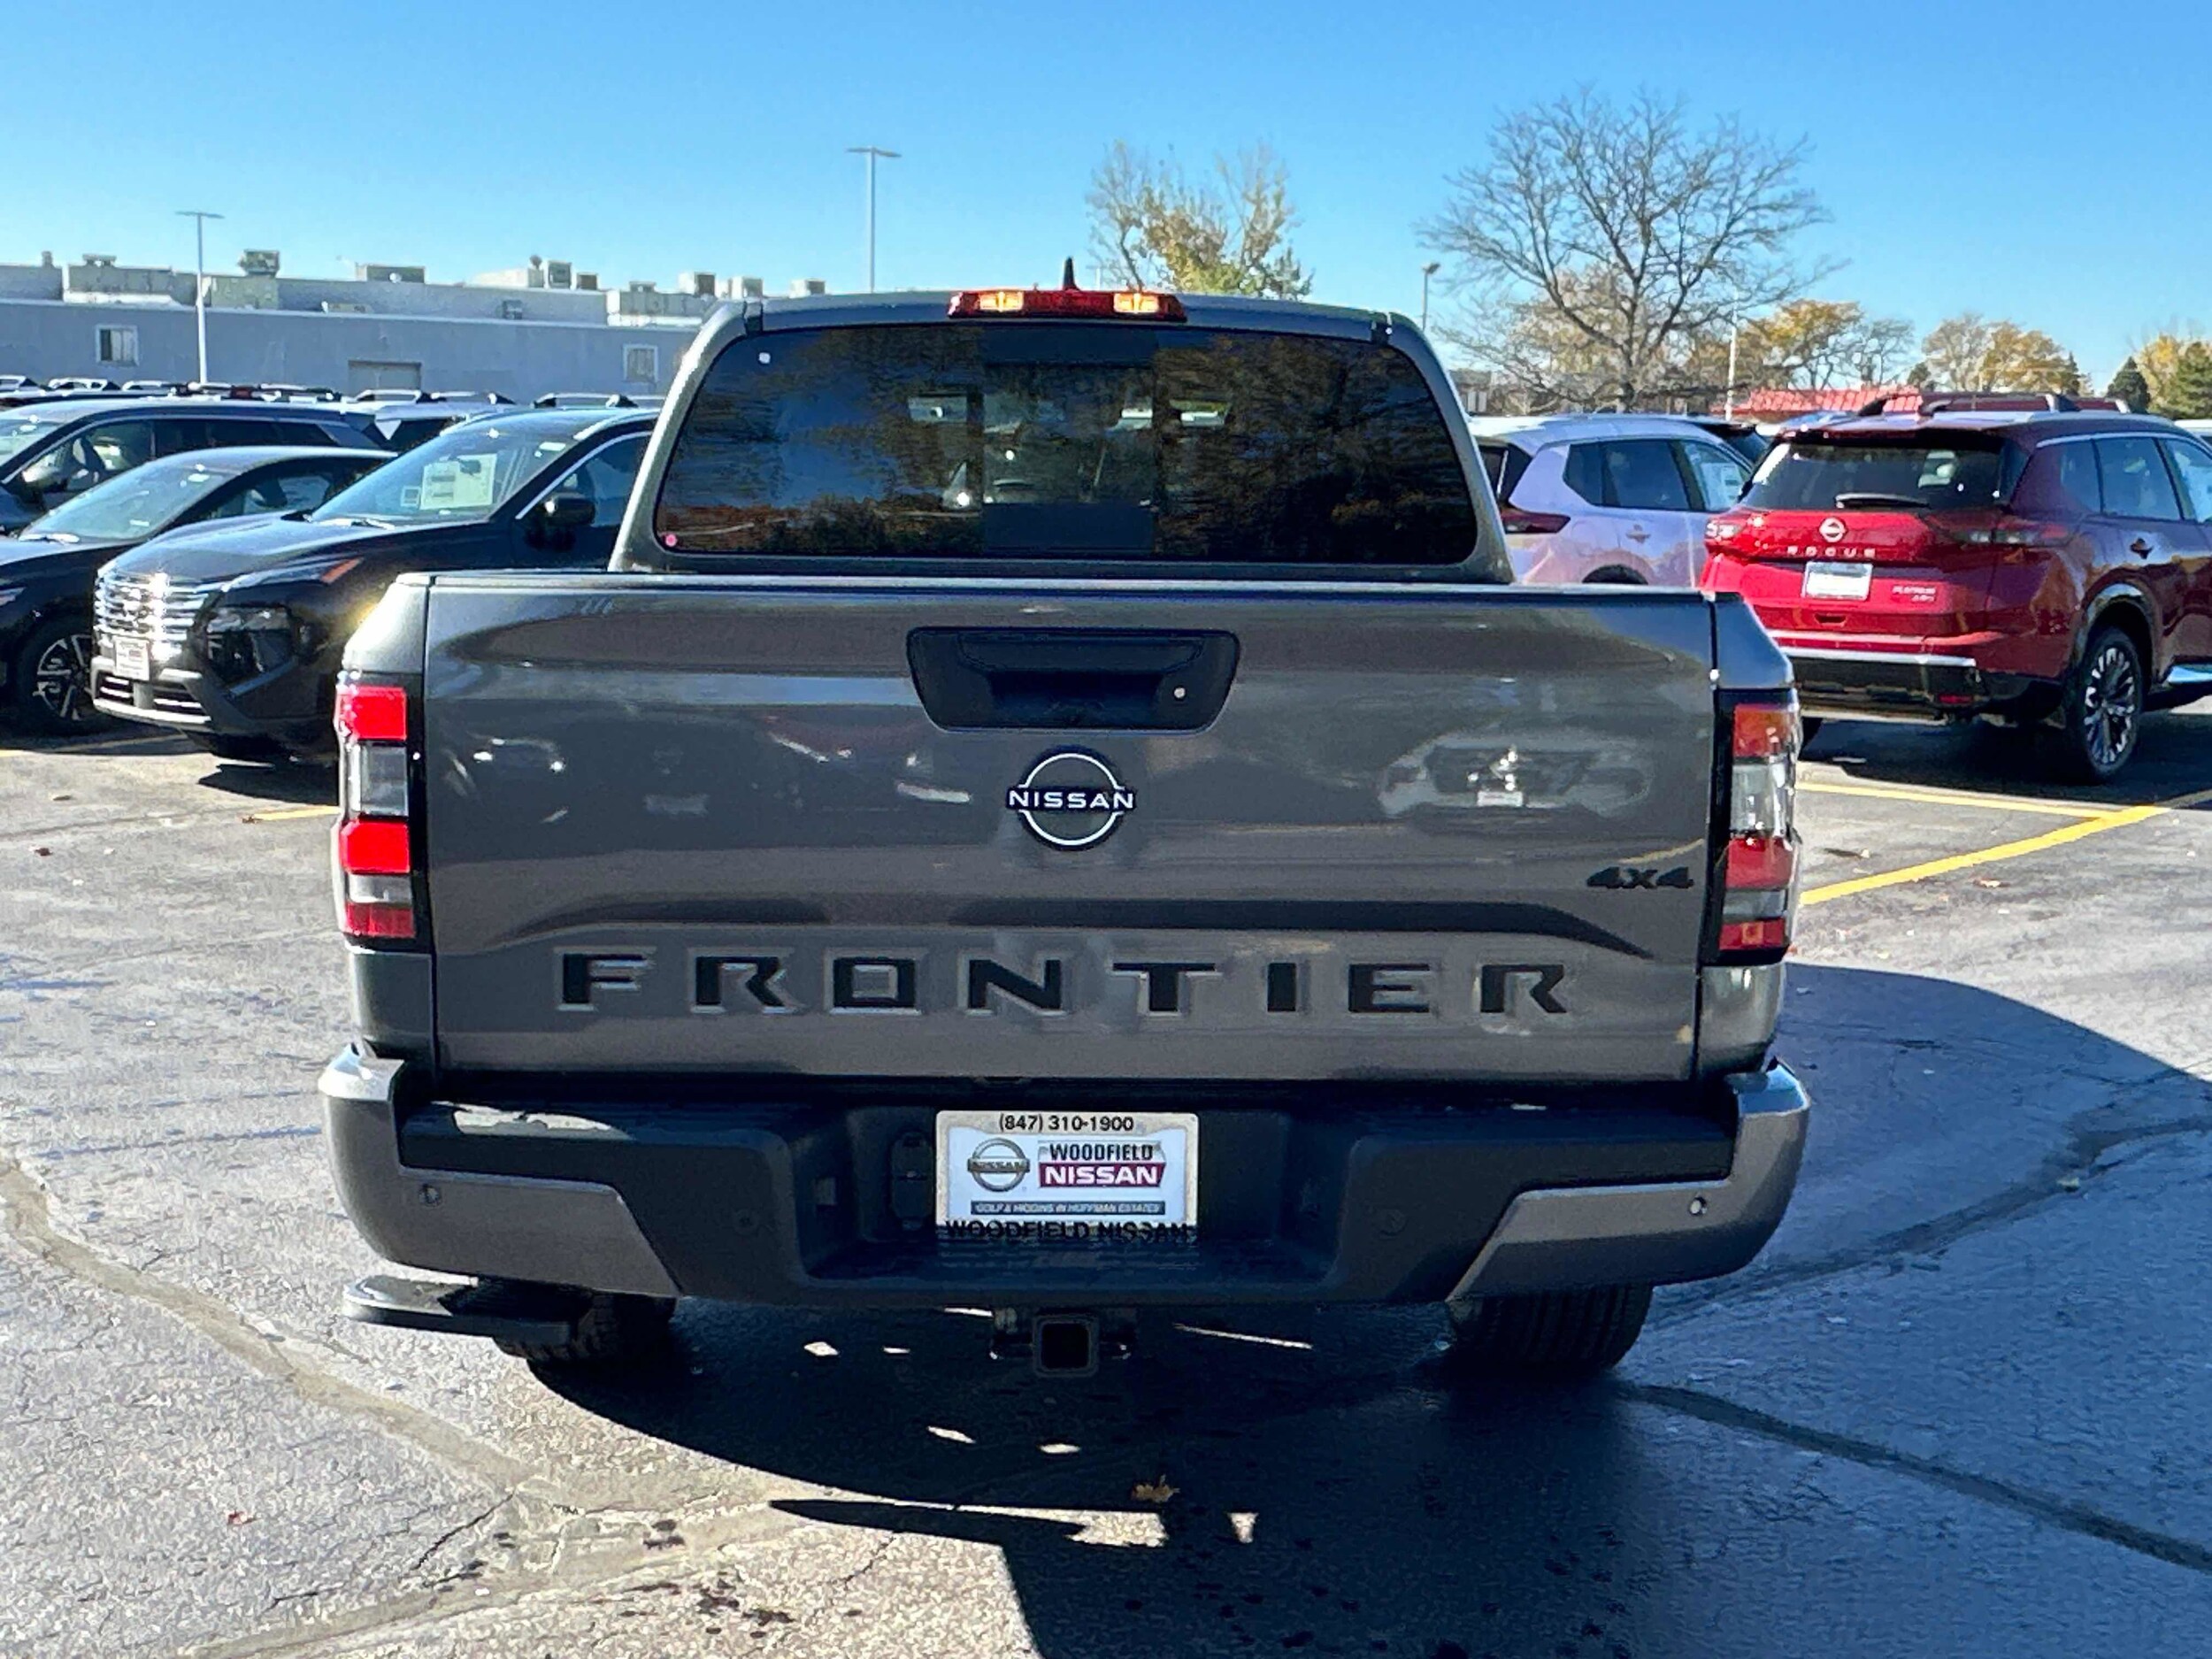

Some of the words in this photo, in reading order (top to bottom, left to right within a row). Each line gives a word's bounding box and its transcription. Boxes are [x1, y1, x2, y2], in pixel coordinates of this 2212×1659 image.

[1009, 790, 1133, 809] NISSAN
[557, 952, 1569, 1015] FRONTIER
[999, 1113, 1043, 1132] (847)
[1048, 1114, 1134, 1132] 310-1900
[1049, 1143, 1154, 1161] WOODFIELD
[1044, 1165, 1158, 1186] NISSAN
[945, 1220, 1090, 1240] WOODFIELD
[1098, 1221, 1194, 1241] NISSAN
